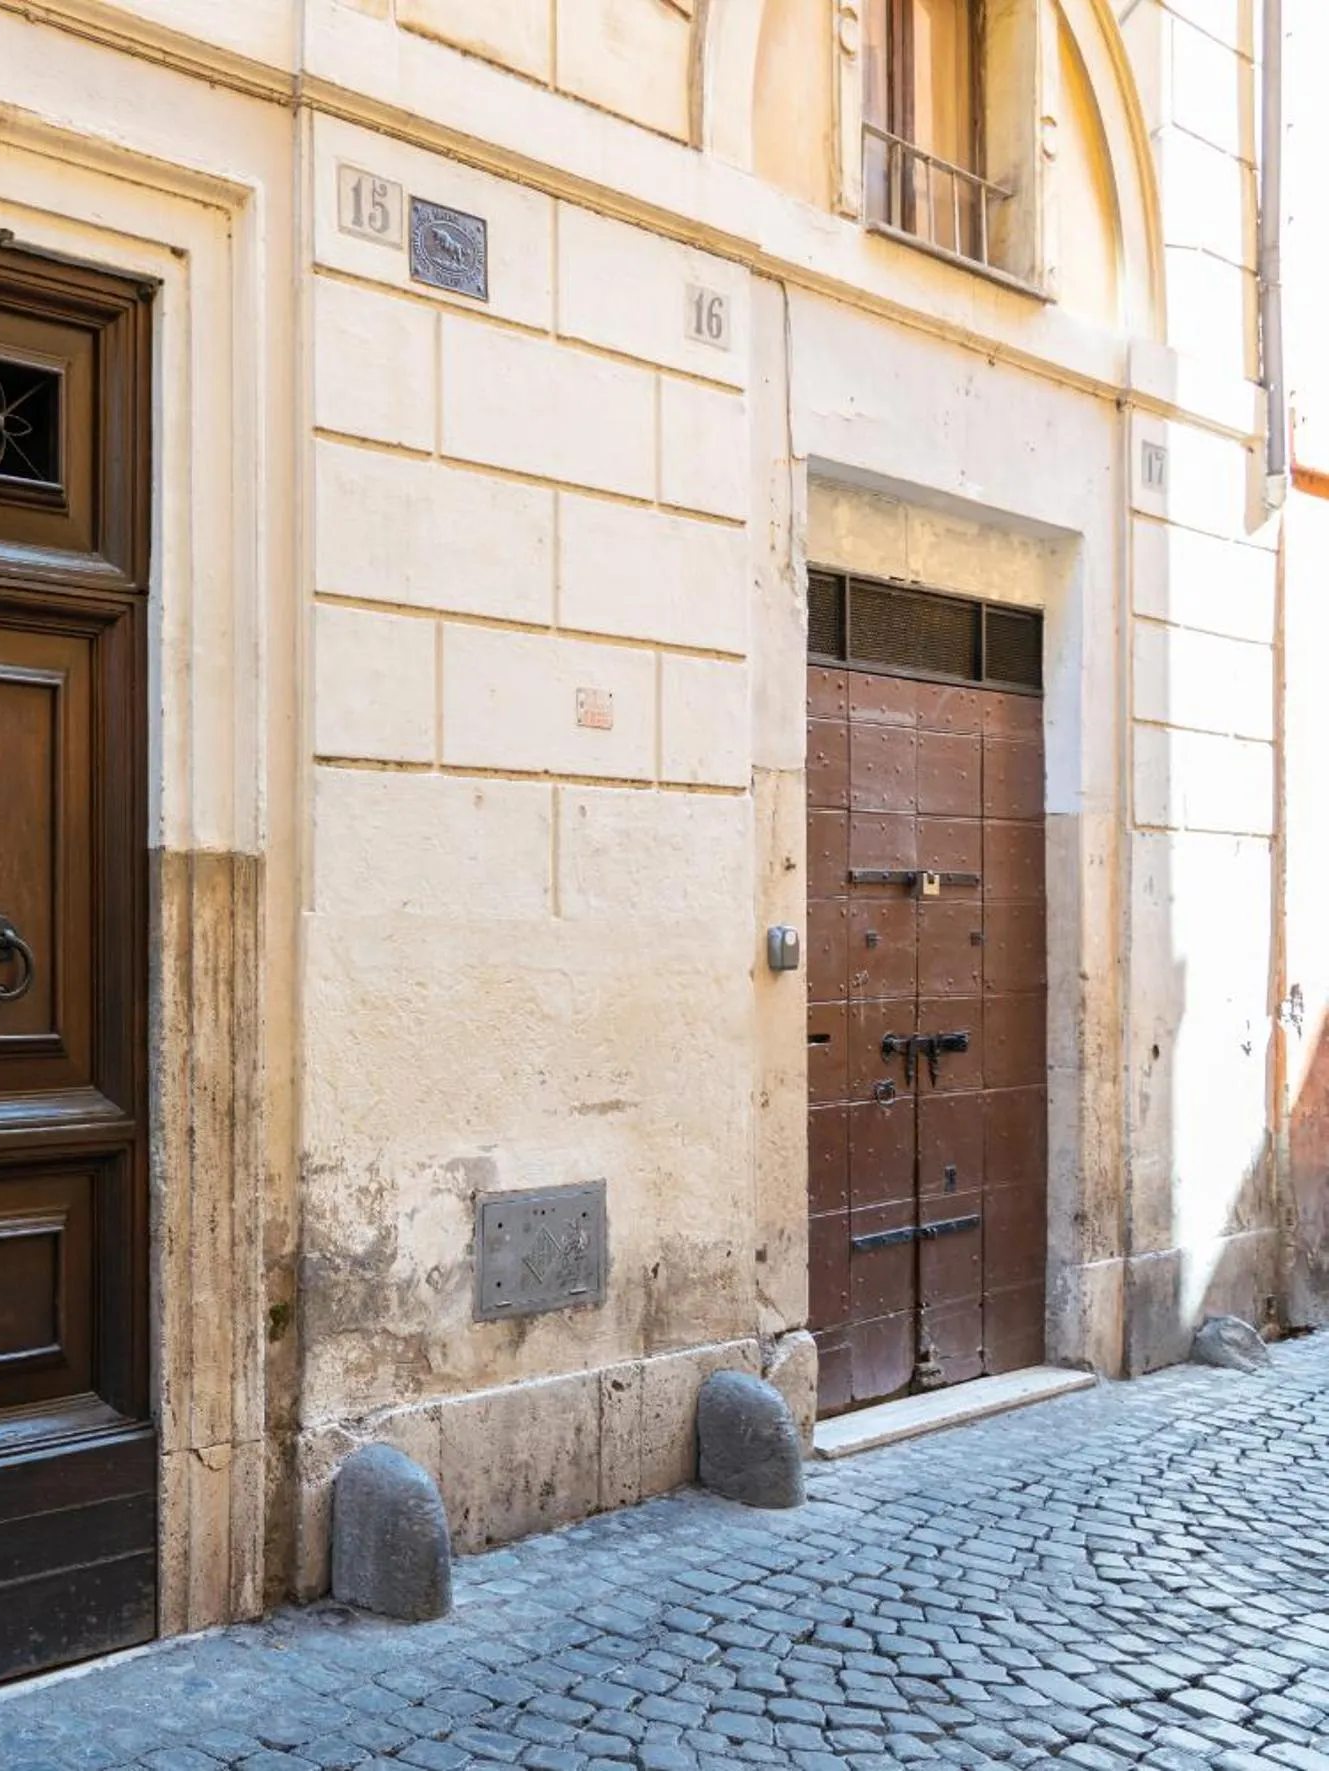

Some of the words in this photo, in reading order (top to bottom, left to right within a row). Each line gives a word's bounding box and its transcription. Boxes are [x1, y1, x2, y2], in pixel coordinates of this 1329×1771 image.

[351, 176, 389, 233] 15
[694, 288, 723, 339] 16
[1147, 451, 1165, 485] 17
